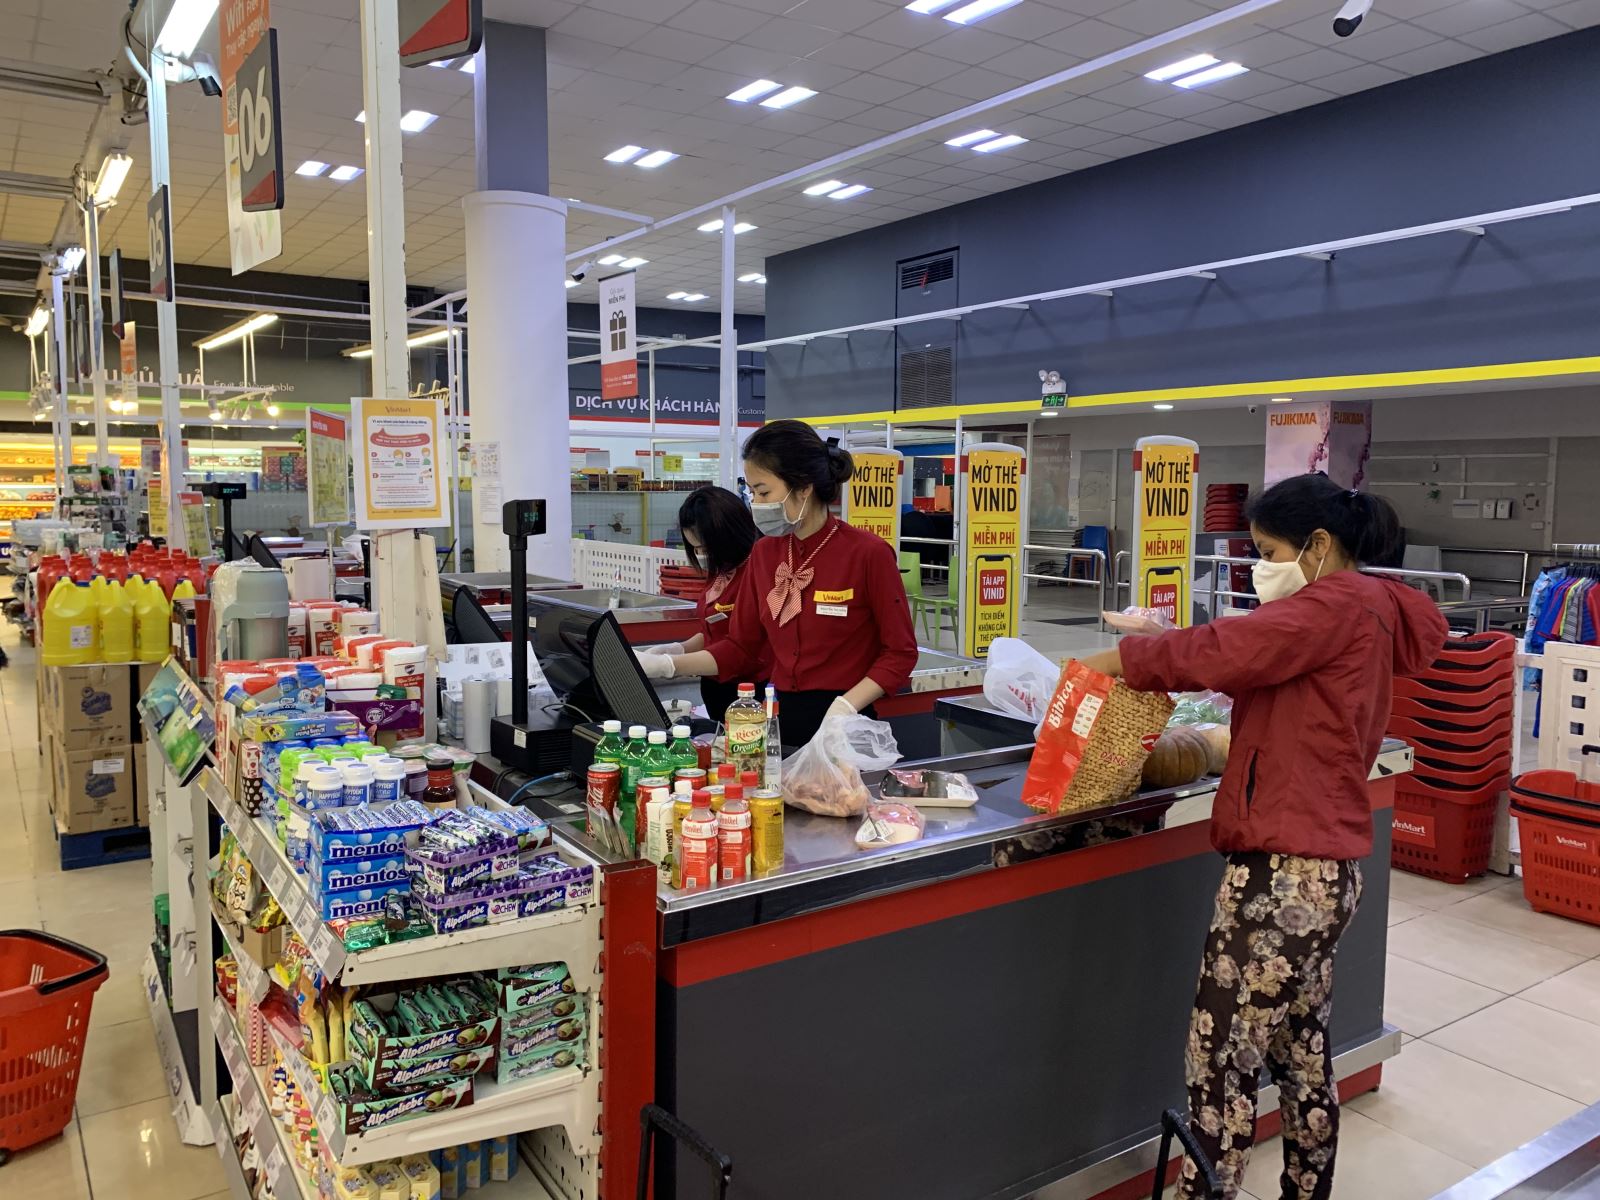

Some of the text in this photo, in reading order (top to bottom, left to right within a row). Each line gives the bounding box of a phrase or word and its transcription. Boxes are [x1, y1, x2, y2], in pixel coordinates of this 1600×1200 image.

[238, 66, 272, 173] 06
[149, 207, 164, 272] 05
[616, 398, 637, 414] VỤ
[640, 396, 690, 412] KHÁCH
[1270, 412, 1318, 426] FUJIKIMA
[1333, 411, 1364, 425] FUJIKIMA
[852, 461, 895, 484] MỞ THẺ
[971, 459, 1018, 485] MỞ THẺ
[1145, 455, 1190, 484] MỞ THẺ
[852, 486, 895, 508] VINID
[972, 487, 1018, 512] VINID
[1145, 488, 1189, 517] VINID
[973, 525, 1016, 545] MIỄN PHÍ
[1145, 533, 1186, 556] MIỄN PHÍ
[982, 574, 1005, 586] TẢI APP
[982, 587, 1005, 600] VINID
[1153, 590, 1176, 604] TẢI APP
[978, 623, 995, 632] KHÔNG
[1047, 680, 1075, 729] Bibica
[735, 728, 762, 741] Ricco
[732, 740, 763, 754] Organic
[1391, 818, 1426, 834] VinMart
[1555, 835, 1587, 849] VinMart
[329, 867, 411, 889] mentos
[450, 863, 489, 888] Alpenliebe
[330, 896, 387, 918] ment
[524, 889, 562, 912] Alpenliebe
[444, 905, 485, 929] Alpenliebe
[527, 983, 560, 1005] Alpenliebe
[398, 1032, 455, 1060] Alpenliebe
[511, 1027, 555, 1055] Alpenliebe
[392, 1057, 450, 1084] Alpenliebe
[366, 1095, 424, 1127] Alpenliebe
